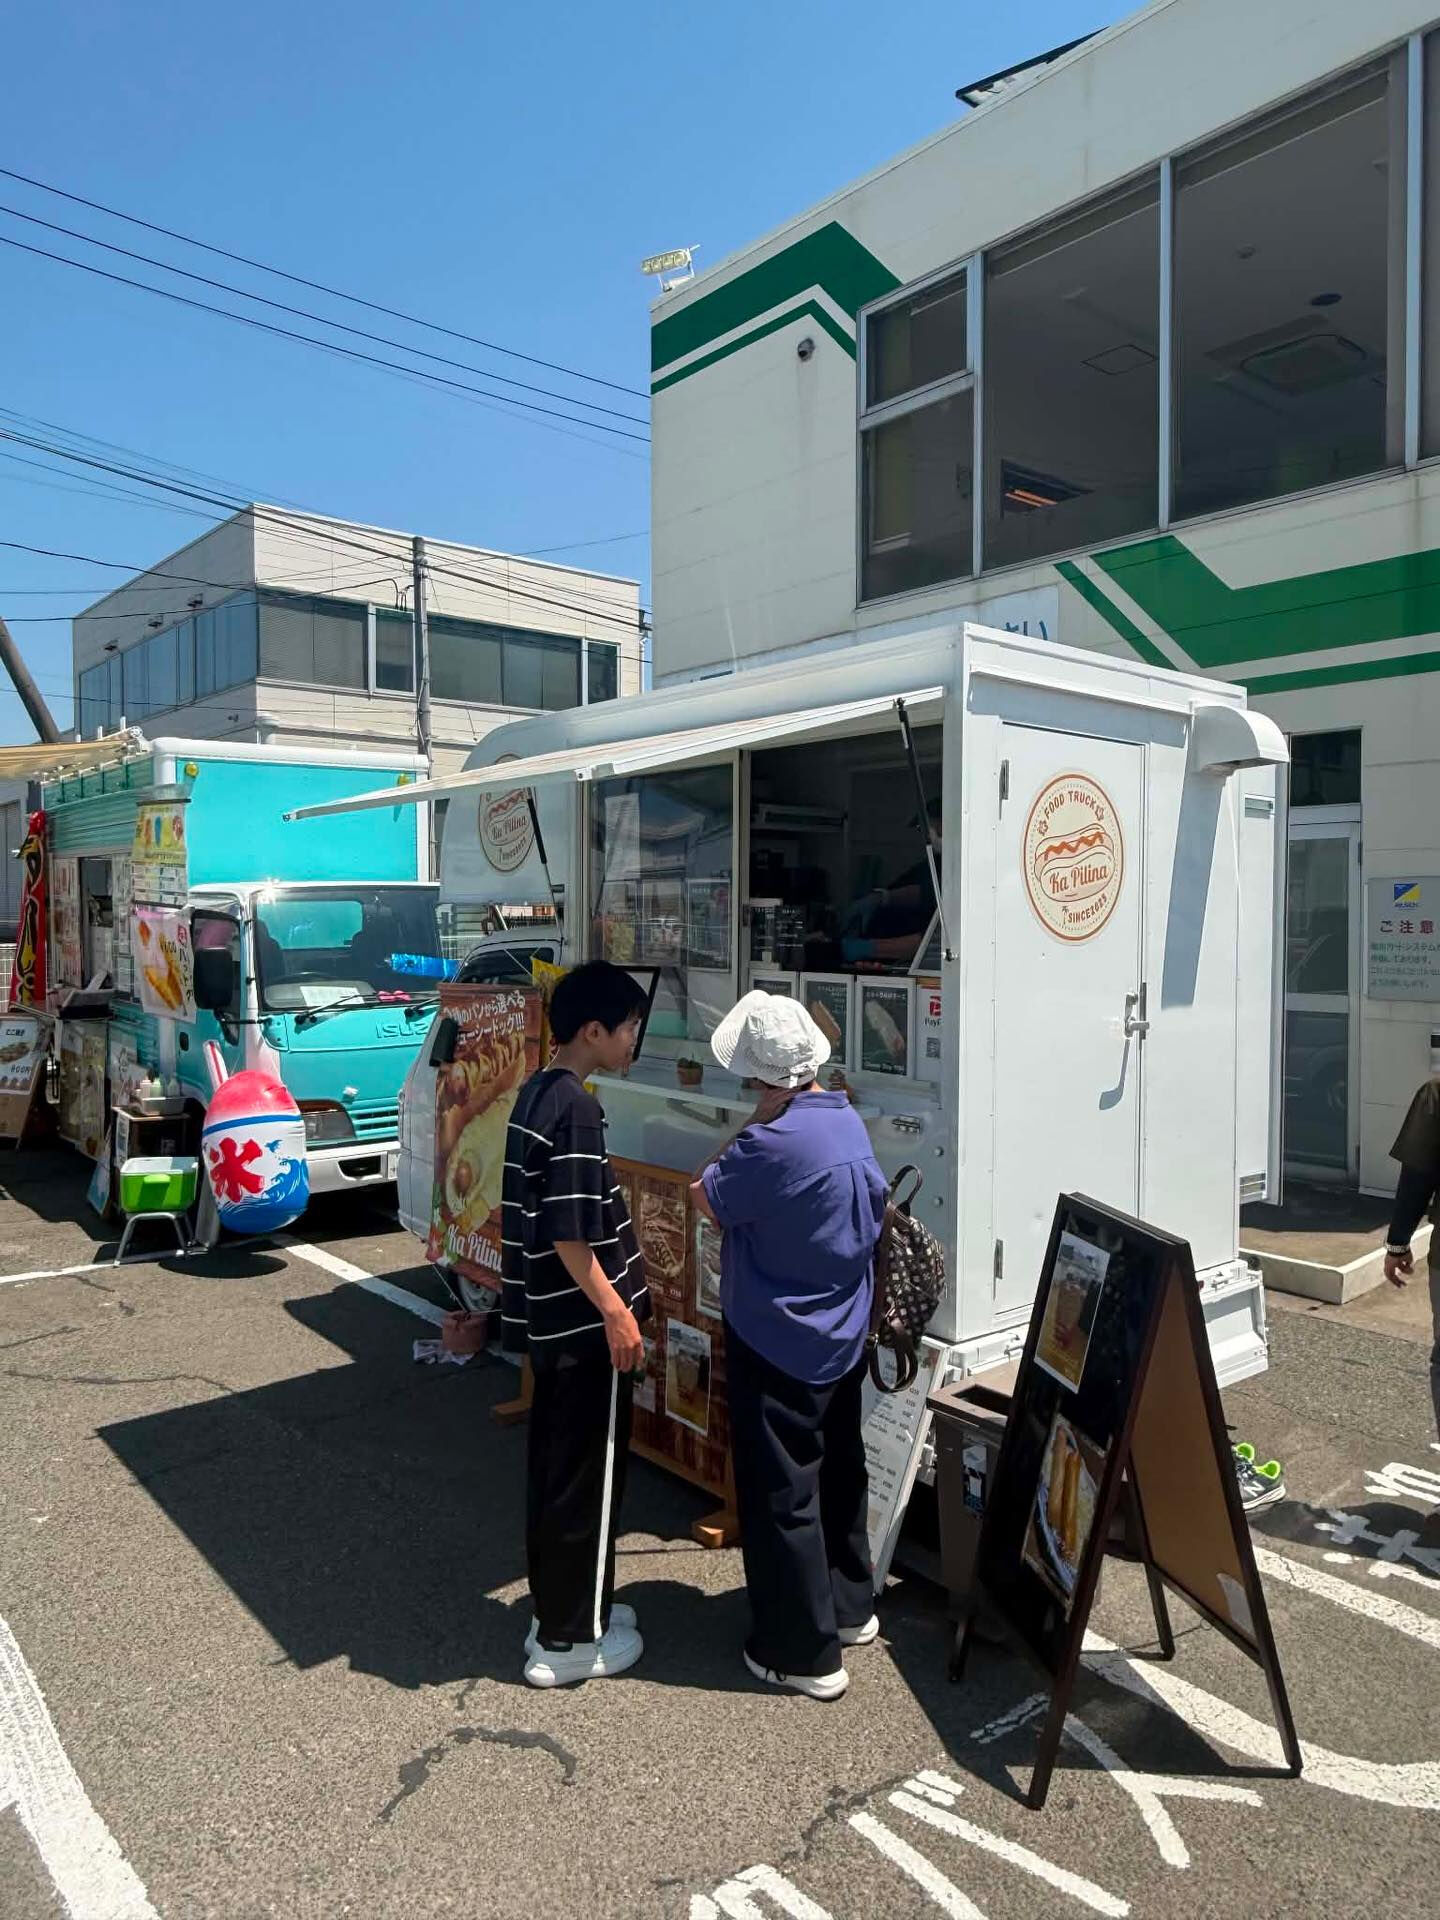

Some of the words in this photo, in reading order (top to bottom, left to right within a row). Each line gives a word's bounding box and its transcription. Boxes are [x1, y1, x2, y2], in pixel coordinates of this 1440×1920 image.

[1044, 793, 1065, 820] FOOD
[1068, 790, 1097, 809] TRUCK
[1049, 871, 1069, 894] Ka
[1070, 864, 1108, 888] Pilina
[1380, 919, 1433, 934] ご注意
[375, 1020, 428, 1039] ISUZ
[210, 1136, 265, 1204] 氷
[448, 1223, 465, 1257] Ka
